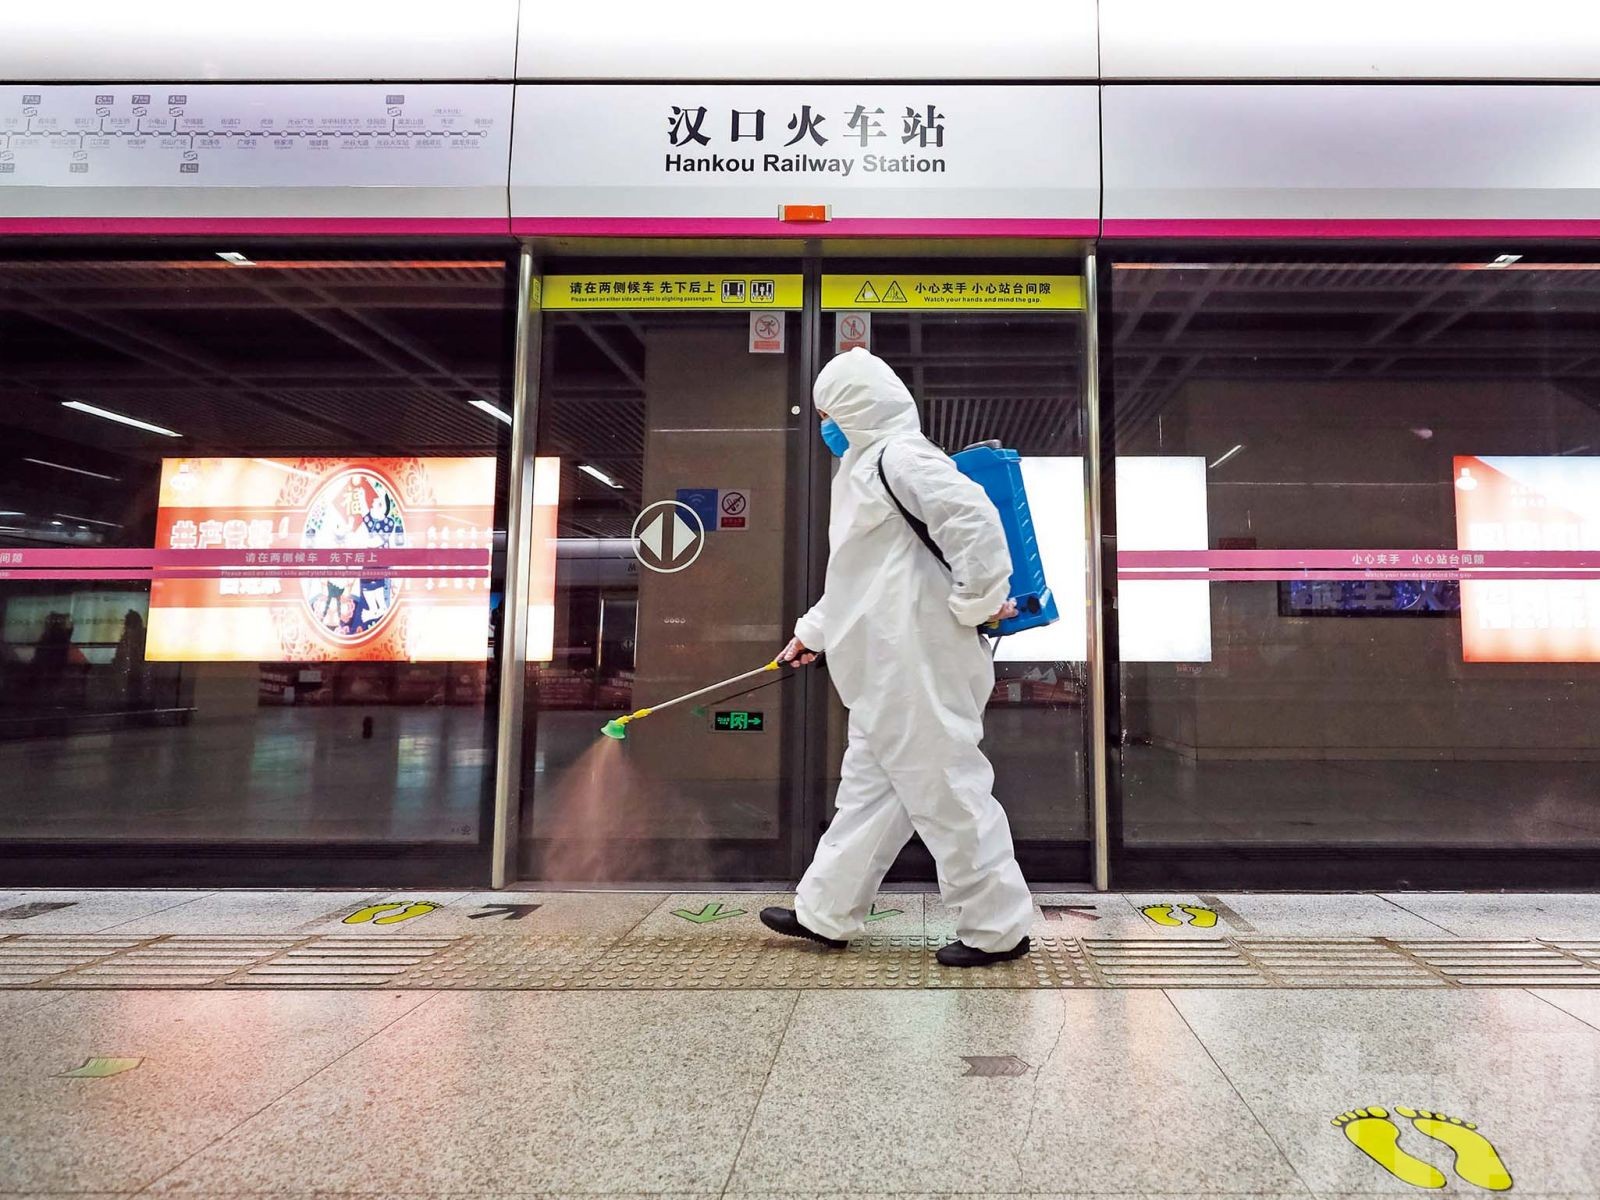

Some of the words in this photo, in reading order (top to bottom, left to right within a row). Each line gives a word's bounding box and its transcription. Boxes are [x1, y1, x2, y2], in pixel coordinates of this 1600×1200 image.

[667, 104, 946, 148] 汉口火车站
[665, 154, 755, 173] Hankou
[763, 154, 855, 177] Railway
[862, 154, 946, 173] Station
[570, 281, 655, 294] 请在两侧候车
[660, 281, 716, 293] 先下后上
[914, 282, 967, 294] 小心夹手
[971, 282, 1051, 294] 小心站台间隙
[245, 552, 318, 563] 请在两侧候车
[329, 552, 378, 563] 先下后上
[1352, 553, 1399, 565] 小心夹手
[1411, 553, 1485, 565] 小心站台间隙
